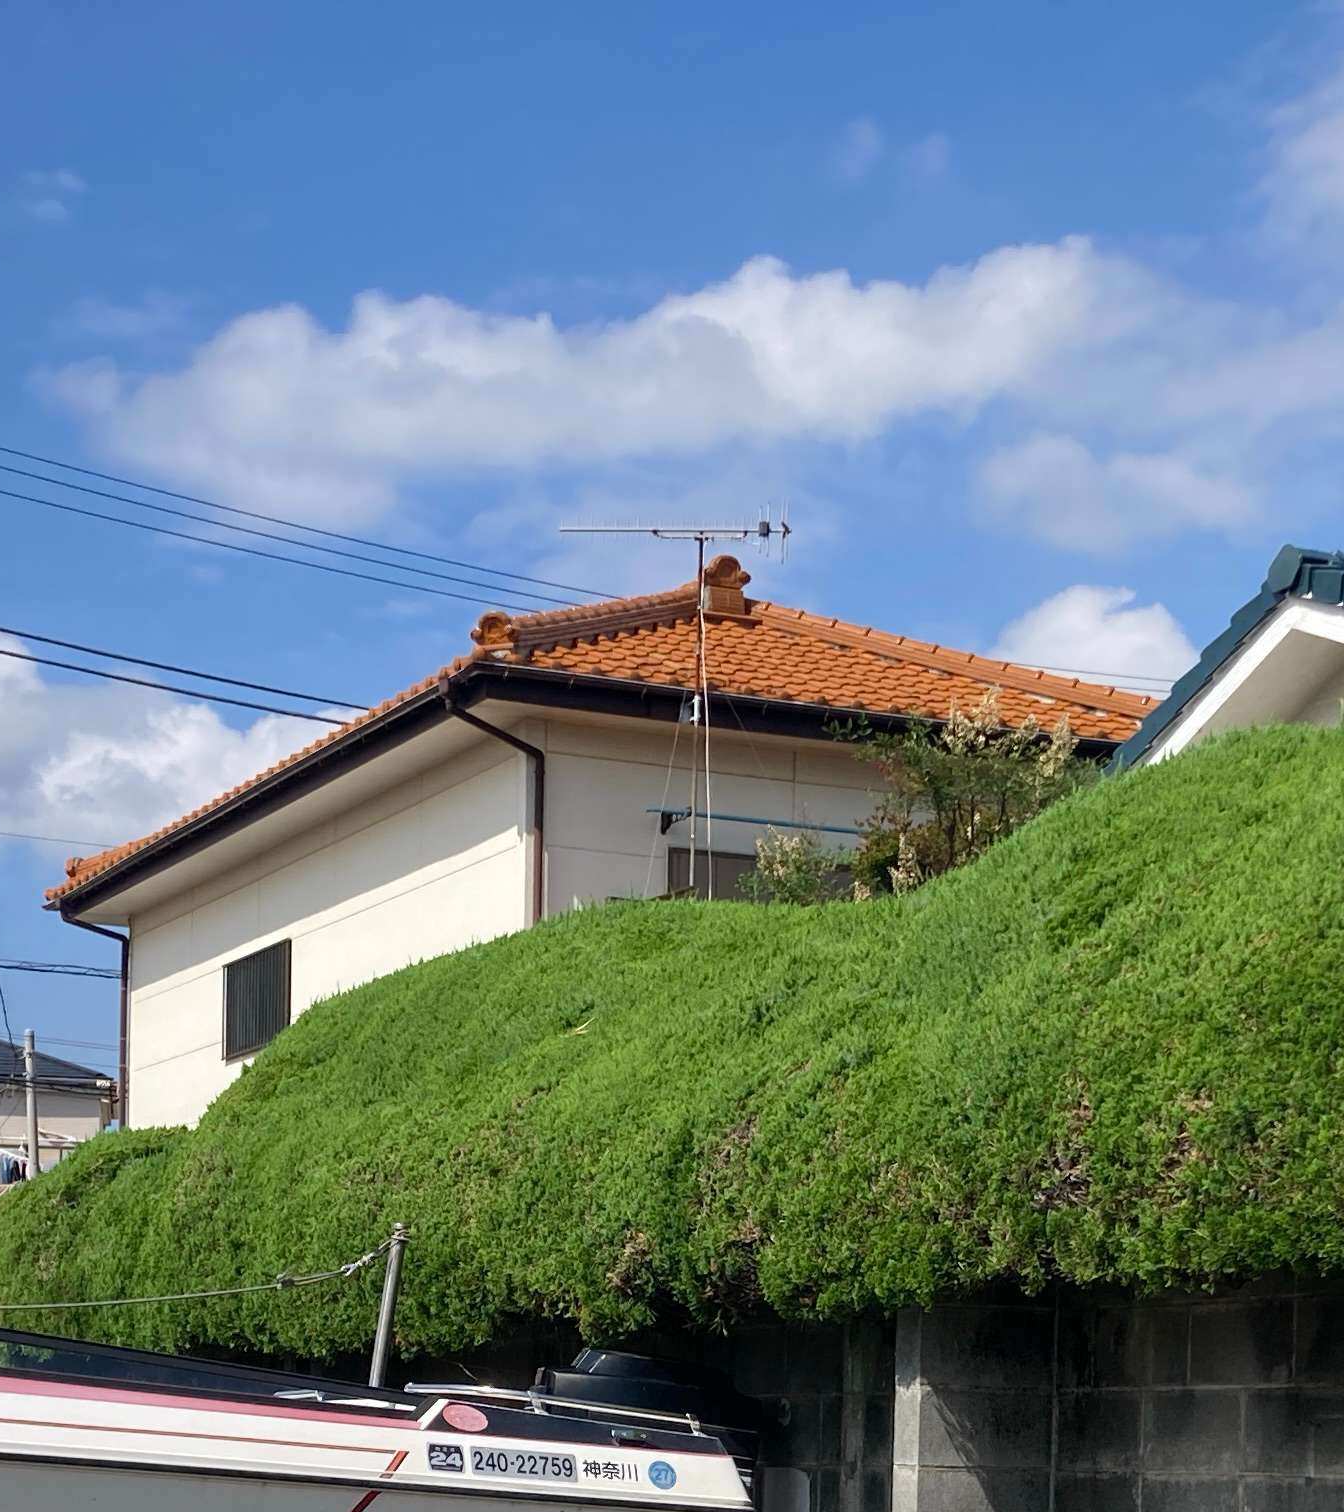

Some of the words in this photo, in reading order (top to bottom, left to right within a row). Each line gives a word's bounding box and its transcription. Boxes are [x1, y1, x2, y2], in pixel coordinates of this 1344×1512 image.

[429, 1453, 463, 1469] 24
[472, 1450, 574, 1478] 240-22759
[582, 1459, 639, 1482] 神奈川
